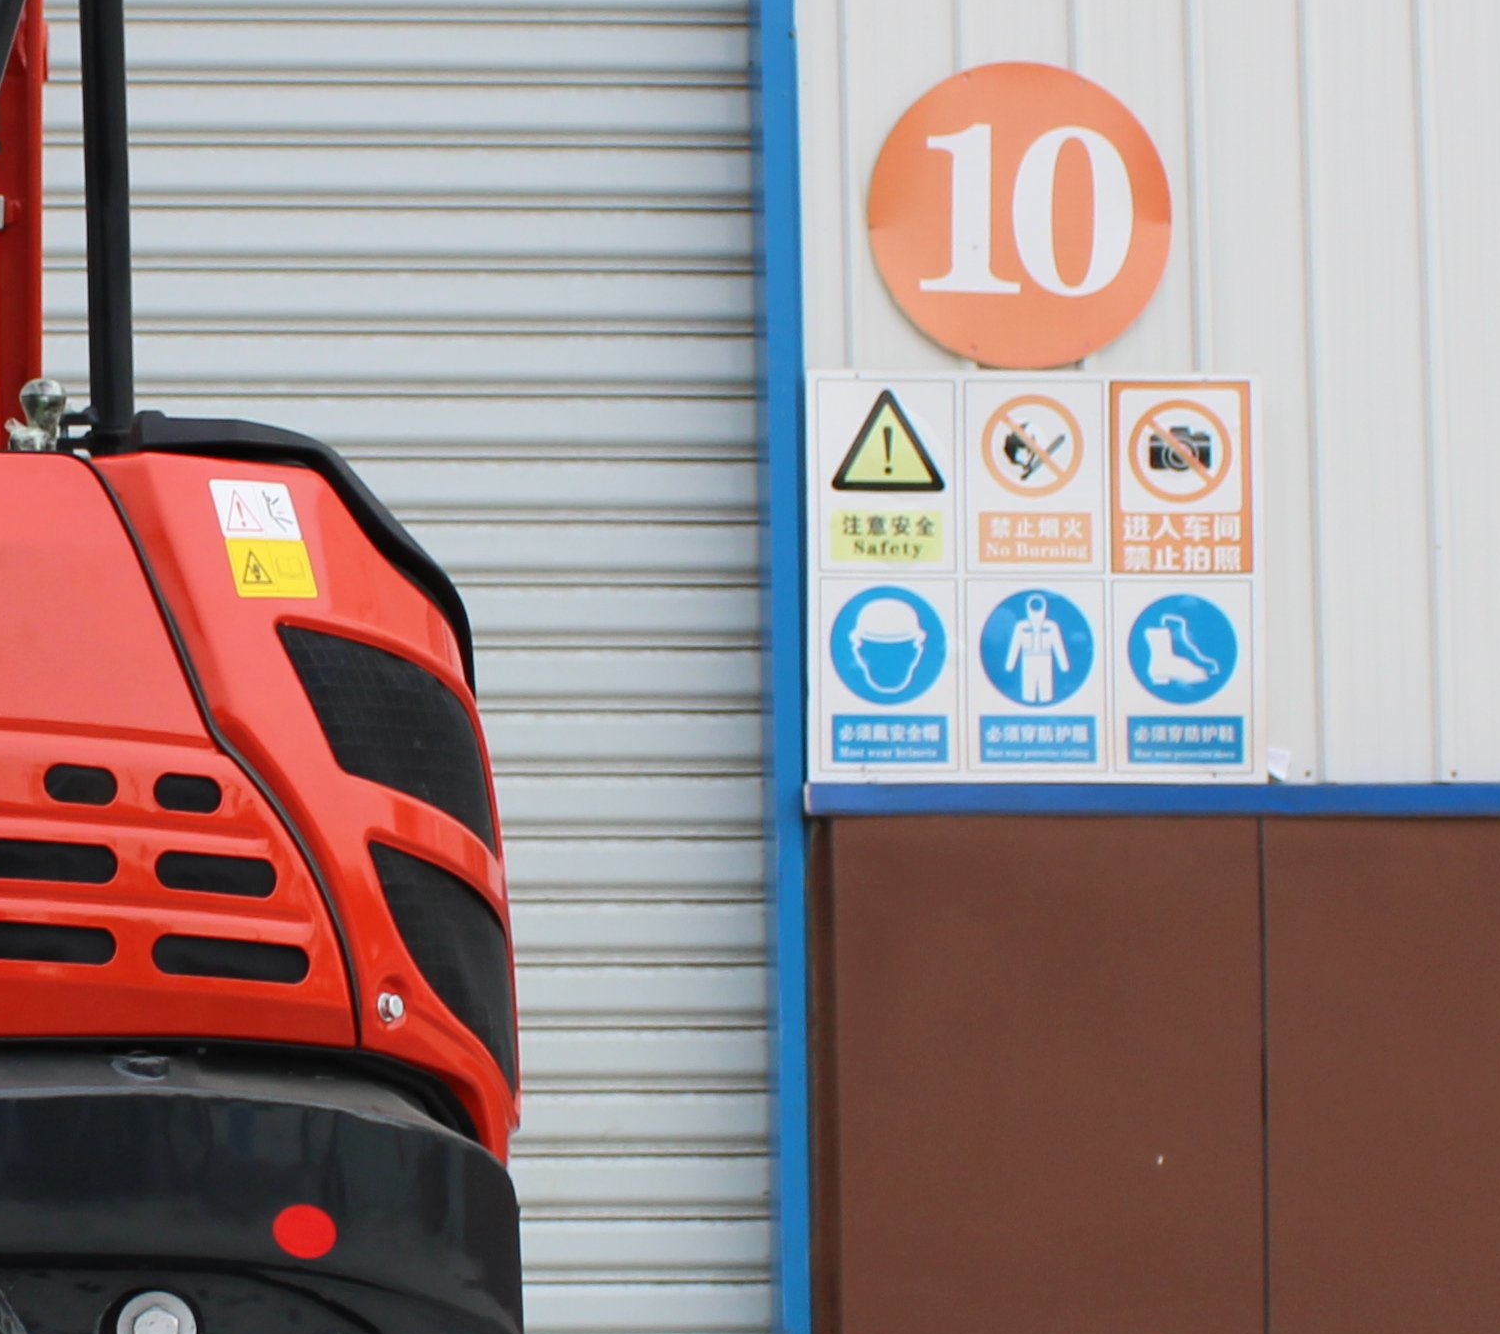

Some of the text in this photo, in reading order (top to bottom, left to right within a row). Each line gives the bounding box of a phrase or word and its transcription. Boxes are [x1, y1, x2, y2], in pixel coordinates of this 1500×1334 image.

[918, 123, 1134, 297] 10
[842, 515, 935, 536] 注意安全
[990, 517, 1083, 539] 禁止烟火
[1122, 514, 1242, 542] 进入车间
[853, 540, 923, 559] Safety
[986, 542, 1088, 559] No Burning
[1122, 545, 1242, 571] 禁止拍照
[839, 723, 940, 742] 必须戴安全帽
